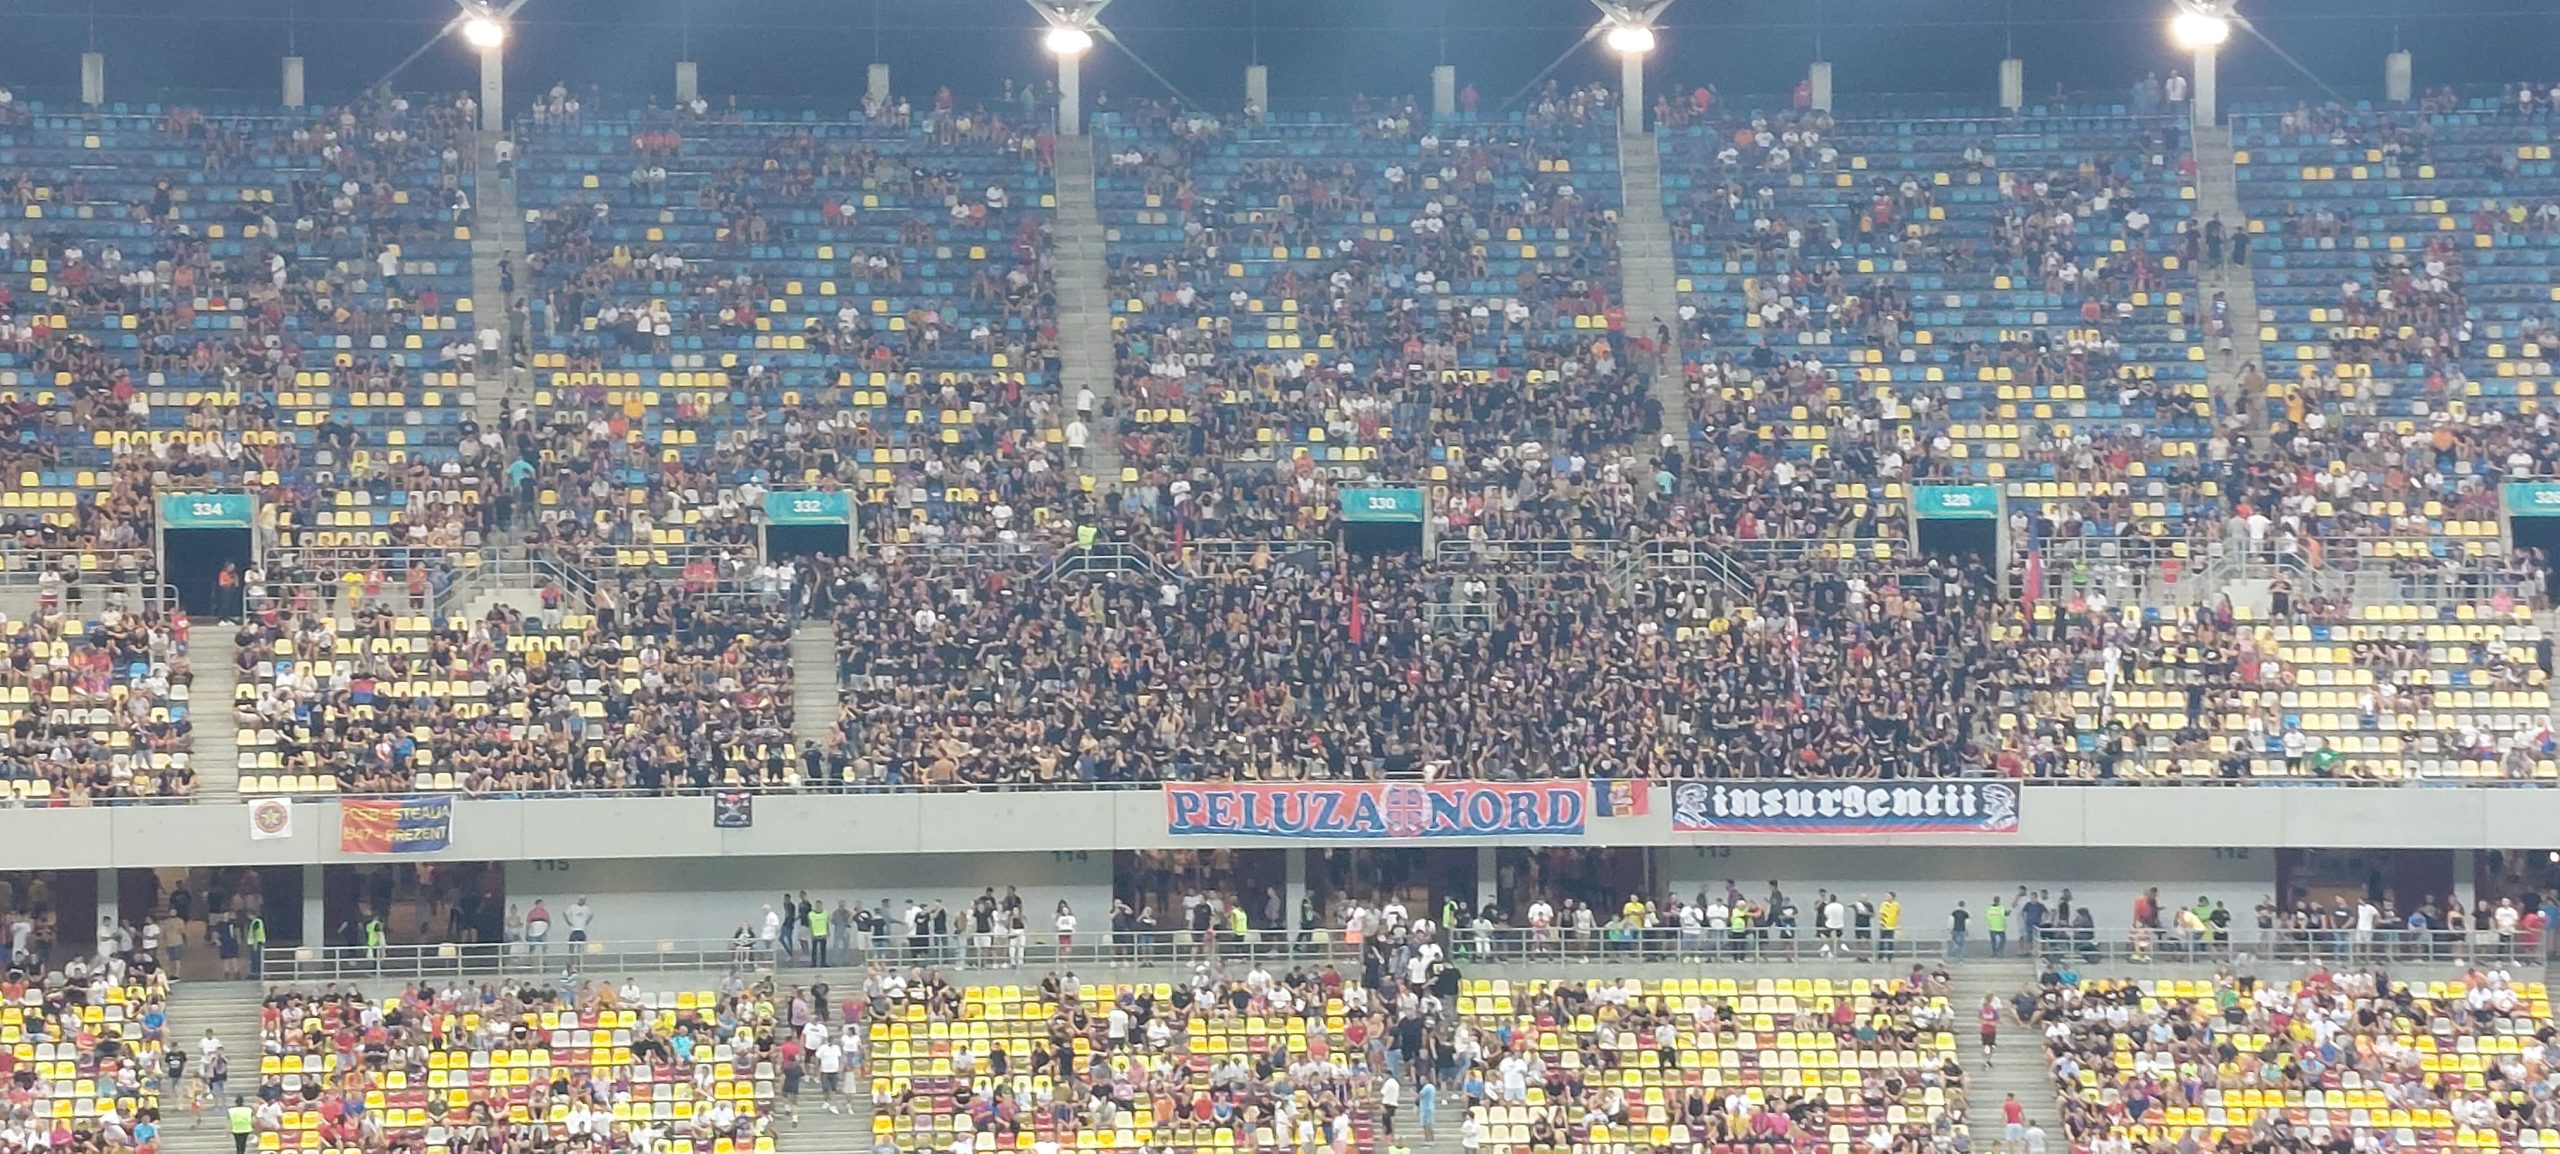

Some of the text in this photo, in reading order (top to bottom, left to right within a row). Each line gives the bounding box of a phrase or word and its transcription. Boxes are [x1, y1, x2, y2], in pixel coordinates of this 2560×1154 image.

[793, 500, 821, 513] 332
[1368, 497, 1396, 510] 330
[1942, 493, 1971, 507] 328
[192, 502, 224, 516] 334
[1712, 784, 1978, 818] insurgentii
[1169, 788, 1583, 833] PELUZA NORD
[385, 826, 448, 842] PREZENT
[533, 858, 570, 872] 115
